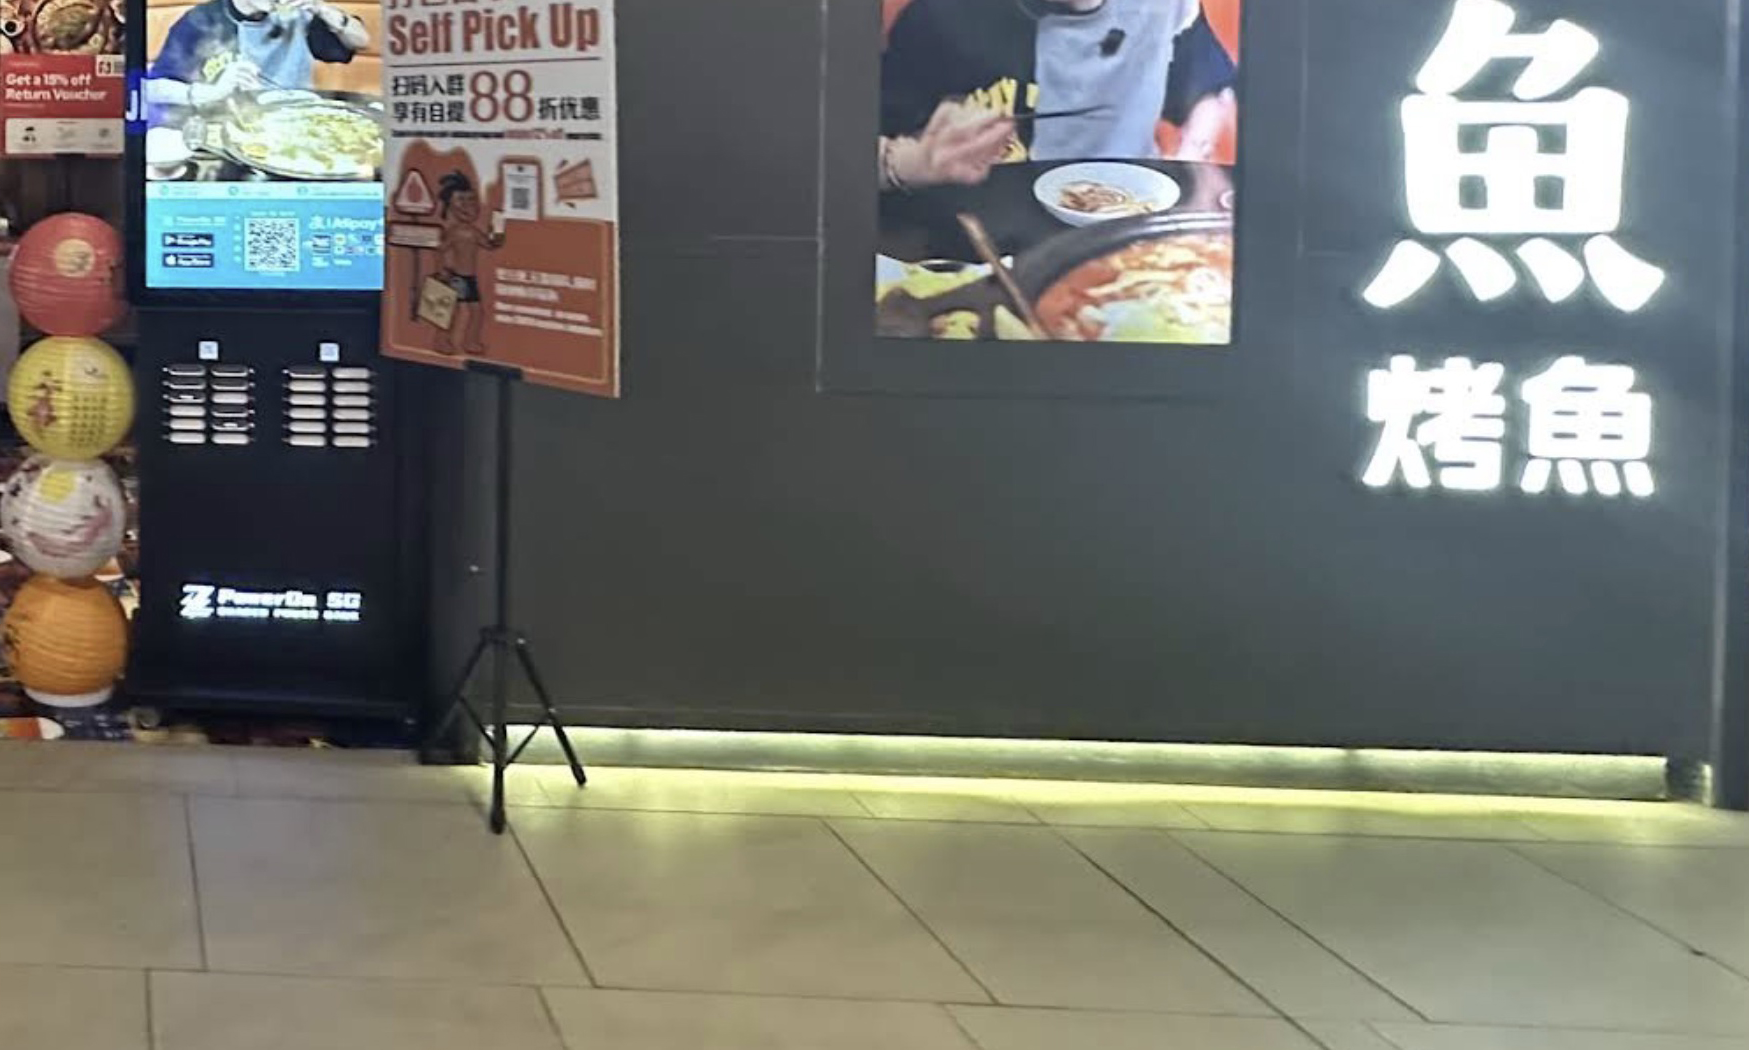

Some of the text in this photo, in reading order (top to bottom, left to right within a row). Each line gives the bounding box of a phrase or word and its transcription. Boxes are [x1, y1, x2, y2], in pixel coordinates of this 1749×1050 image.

[388, 2, 600, 56] Self Pick Up
[5, 73, 31, 86] Get
[71, 73, 92, 86] off
[5, 88, 107, 101] Return Voucher
[469, 69, 534, 123] 88
[1363, 356, 1655, 497] 烤魚
[326, 592, 362, 609] SG
